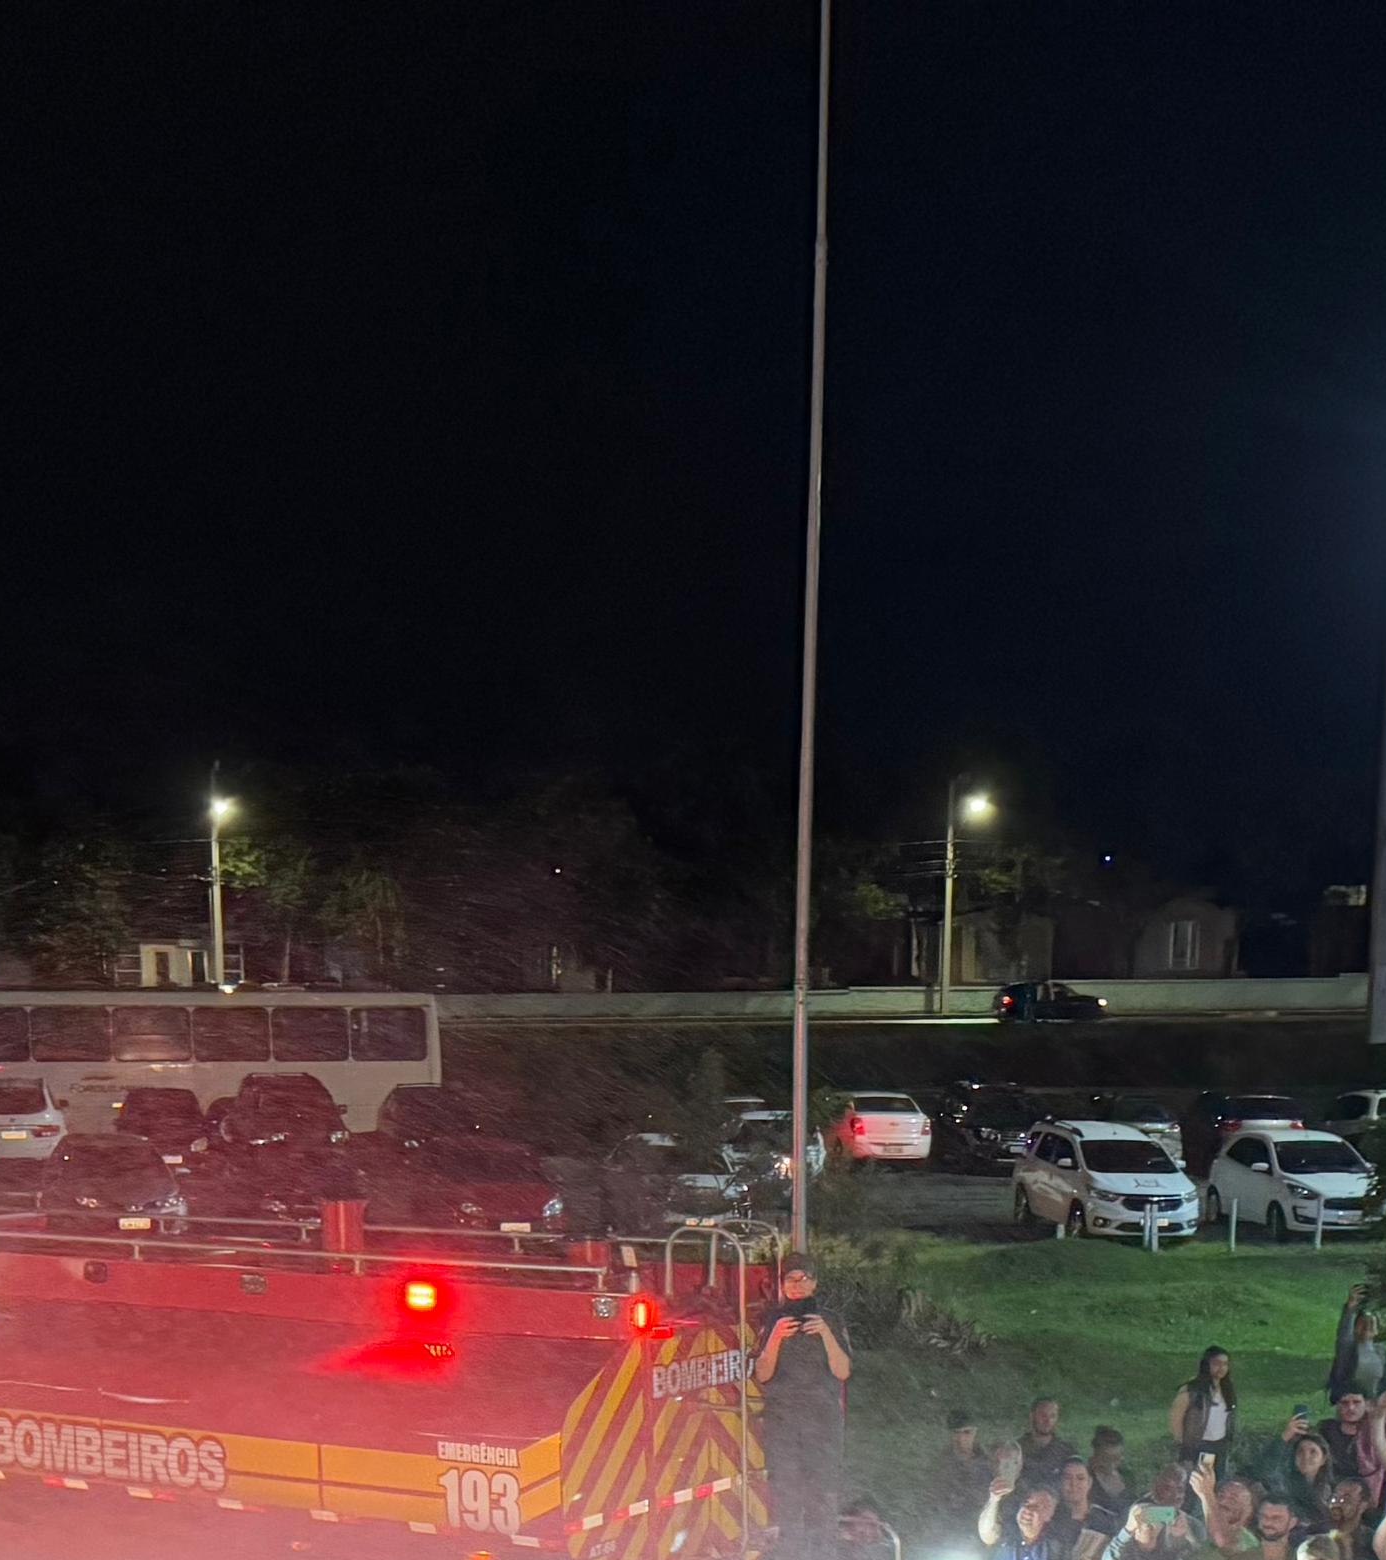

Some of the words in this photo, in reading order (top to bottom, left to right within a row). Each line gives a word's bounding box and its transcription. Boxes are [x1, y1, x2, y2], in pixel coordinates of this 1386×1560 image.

[652, 1348, 755, 1399] BOMBEIRO
[437, 1440, 519, 1468] EMERGÊNCIA
[438, 1467, 521, 1536] 193
